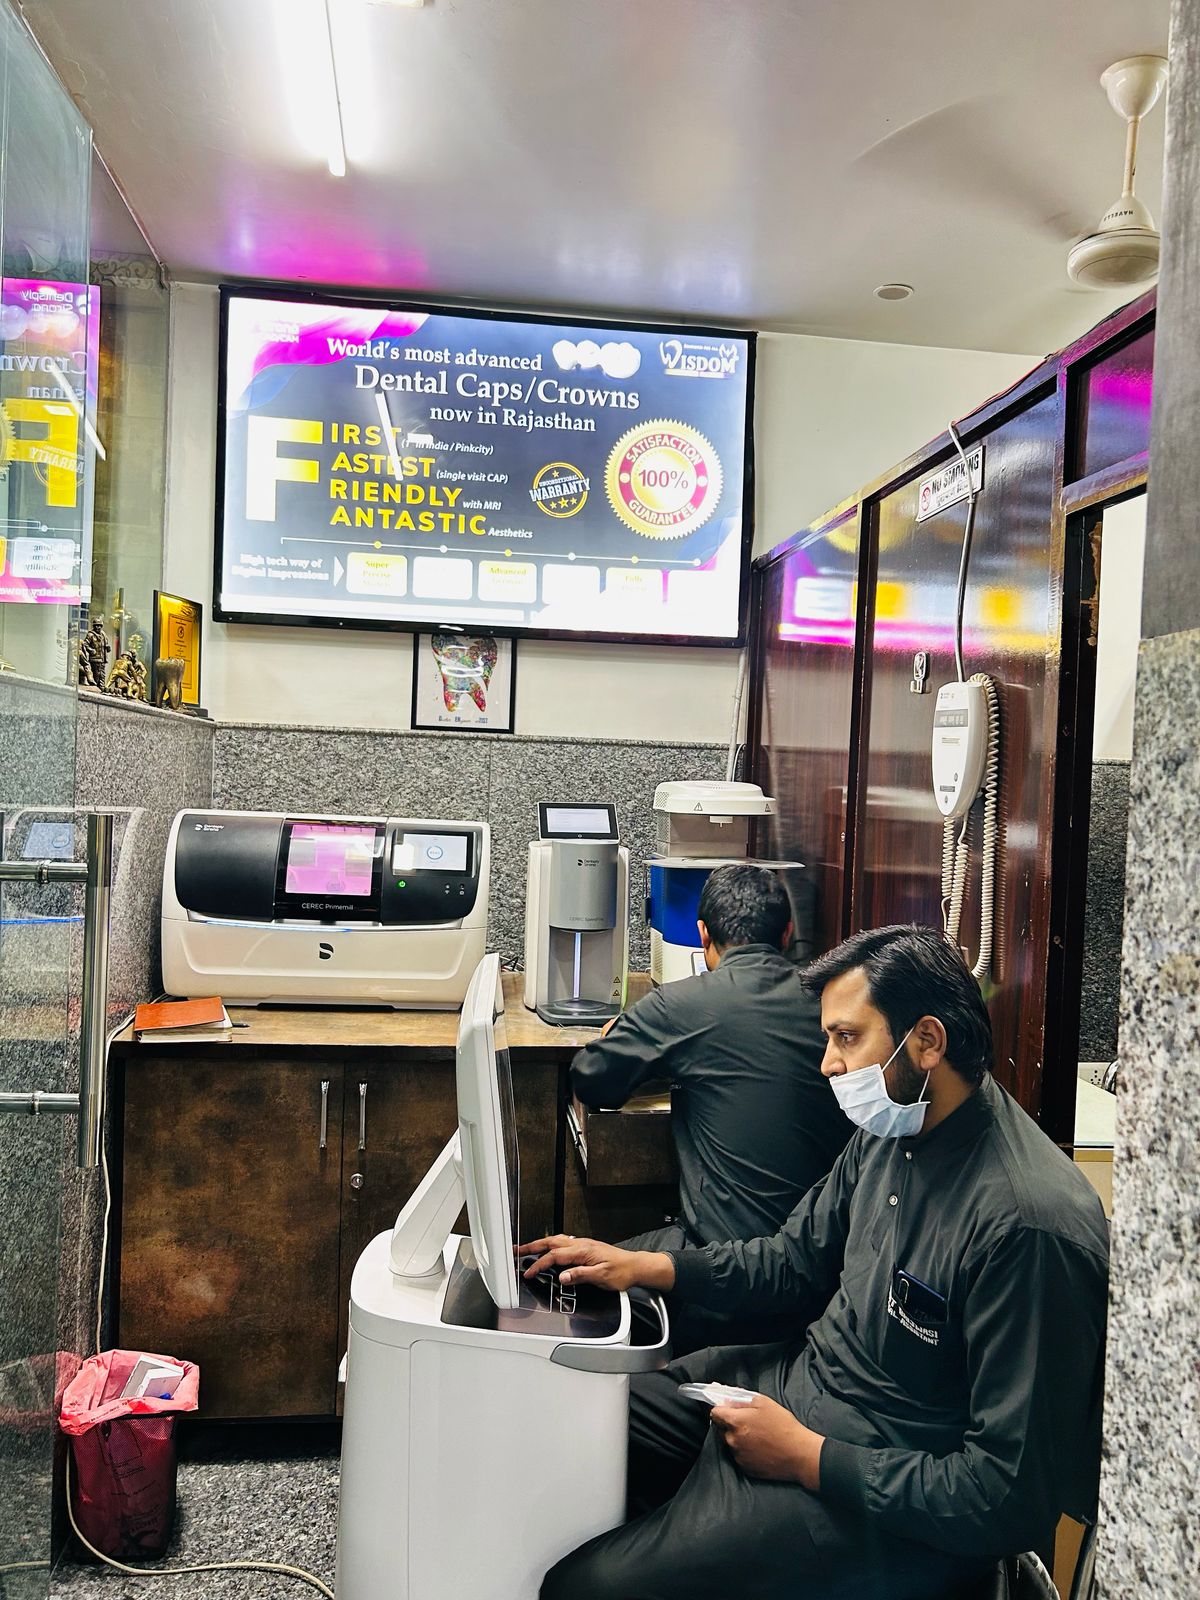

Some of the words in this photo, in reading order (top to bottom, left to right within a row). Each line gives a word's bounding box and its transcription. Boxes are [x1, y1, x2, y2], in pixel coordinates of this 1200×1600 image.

[327, 337, 400, 360] World's
[404, 347, 451, 364] most
[454, 349, 543, 372] advanced
[659, 339, 737, 374] WISDOM
[354, 364, 449, 395] Dental
[455, 373, 640, 410] Caps/Crowns
[429, 406, 473, 424] now
[476, 406, 498, 425] in
[501, 408, 596, 433] Rajasthan
[626, 434, 703, 466] SATISFACTION
[436, 469, 466, 482] (single
[466, 472, 487, 482] visit
[487, 473, 509, 484] CAP)
[528, 477, 591, 502] WARRANTY
[638, 469, 689, 489] 100%
[330, 479, 463, 508] RIENDLY
[462, 499, 483, 510] with
[483, 500, 502, 511] MRI
[329, 505, 487, 536] ANTASTIC
[628, 499, 698, 526] GUARANTEE
[487, 527, 534, 539] Aesthetics
[288, 558, 309, 569] way
[310, 558, 324, 568] of
[301, 902, 325, 910] CEREC
